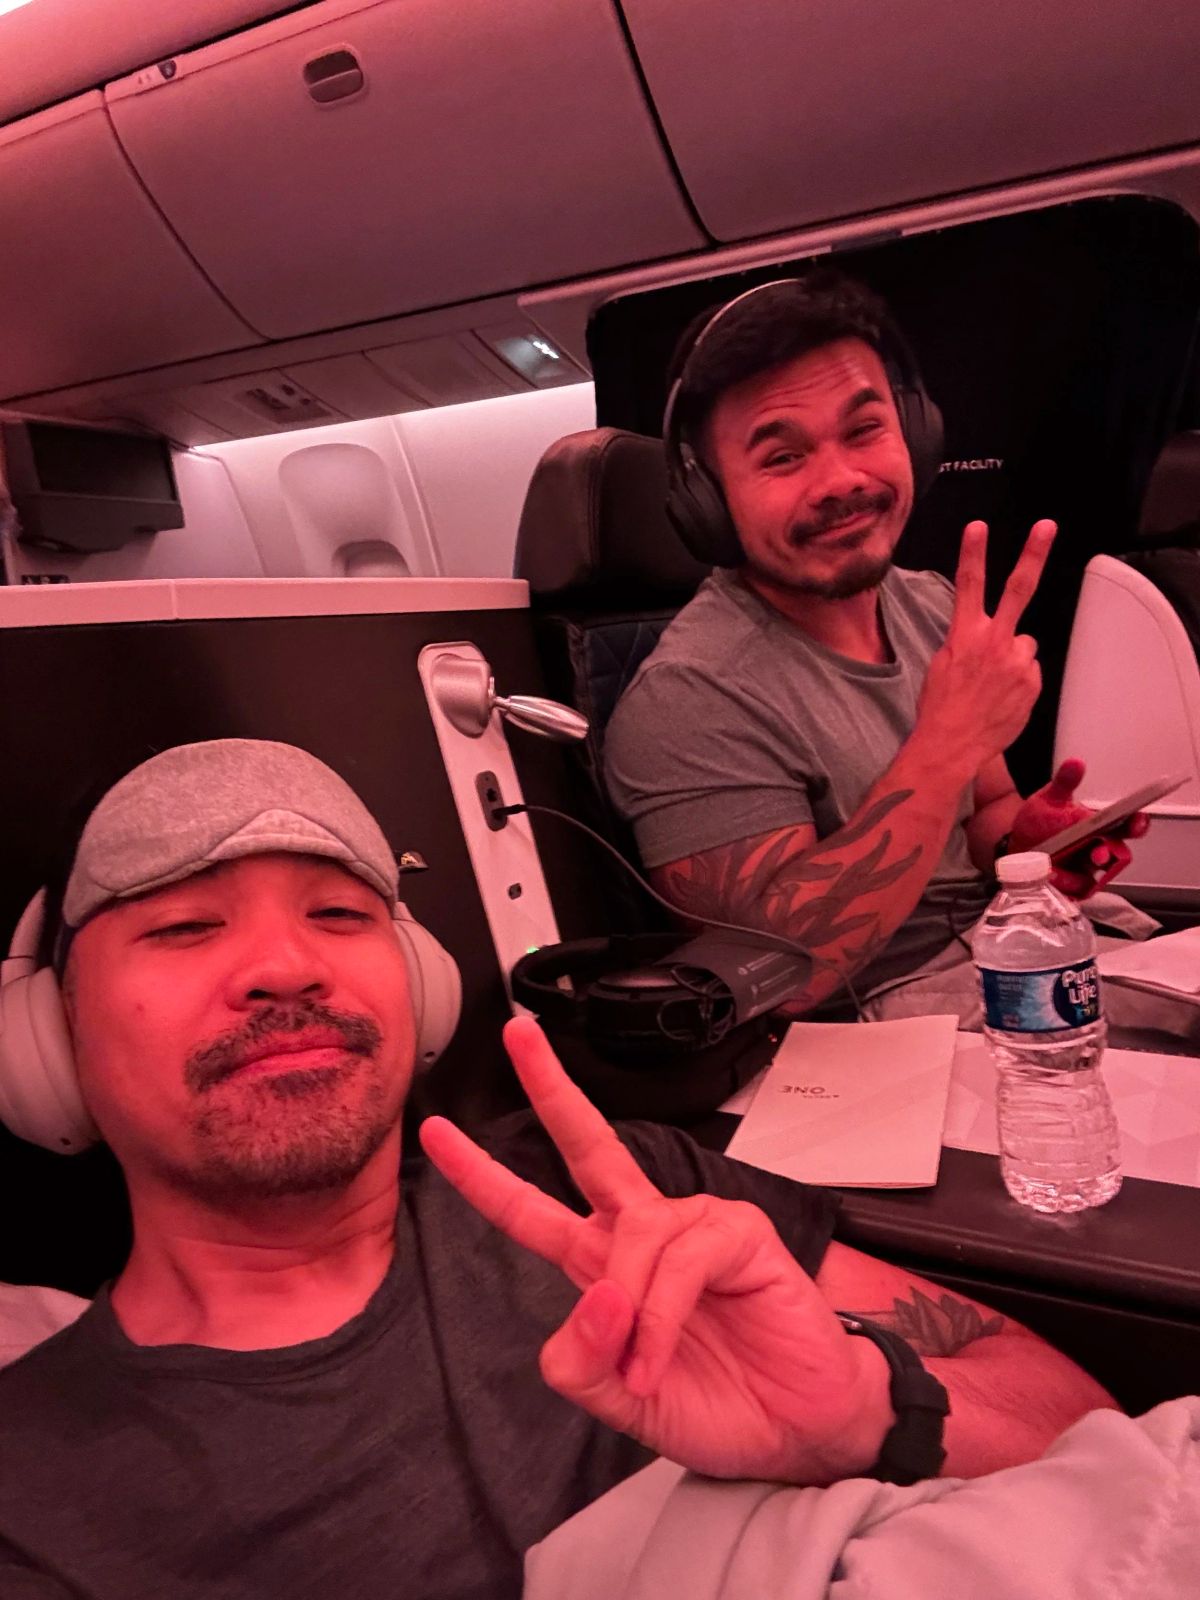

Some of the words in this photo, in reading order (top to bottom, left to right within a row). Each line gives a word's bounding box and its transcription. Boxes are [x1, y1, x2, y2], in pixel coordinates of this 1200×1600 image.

[953, 458, 1004, 471] FACILITY
[1062, 965, 1098, 988] Pure
[1068, 983, 1098, 1005] Life
